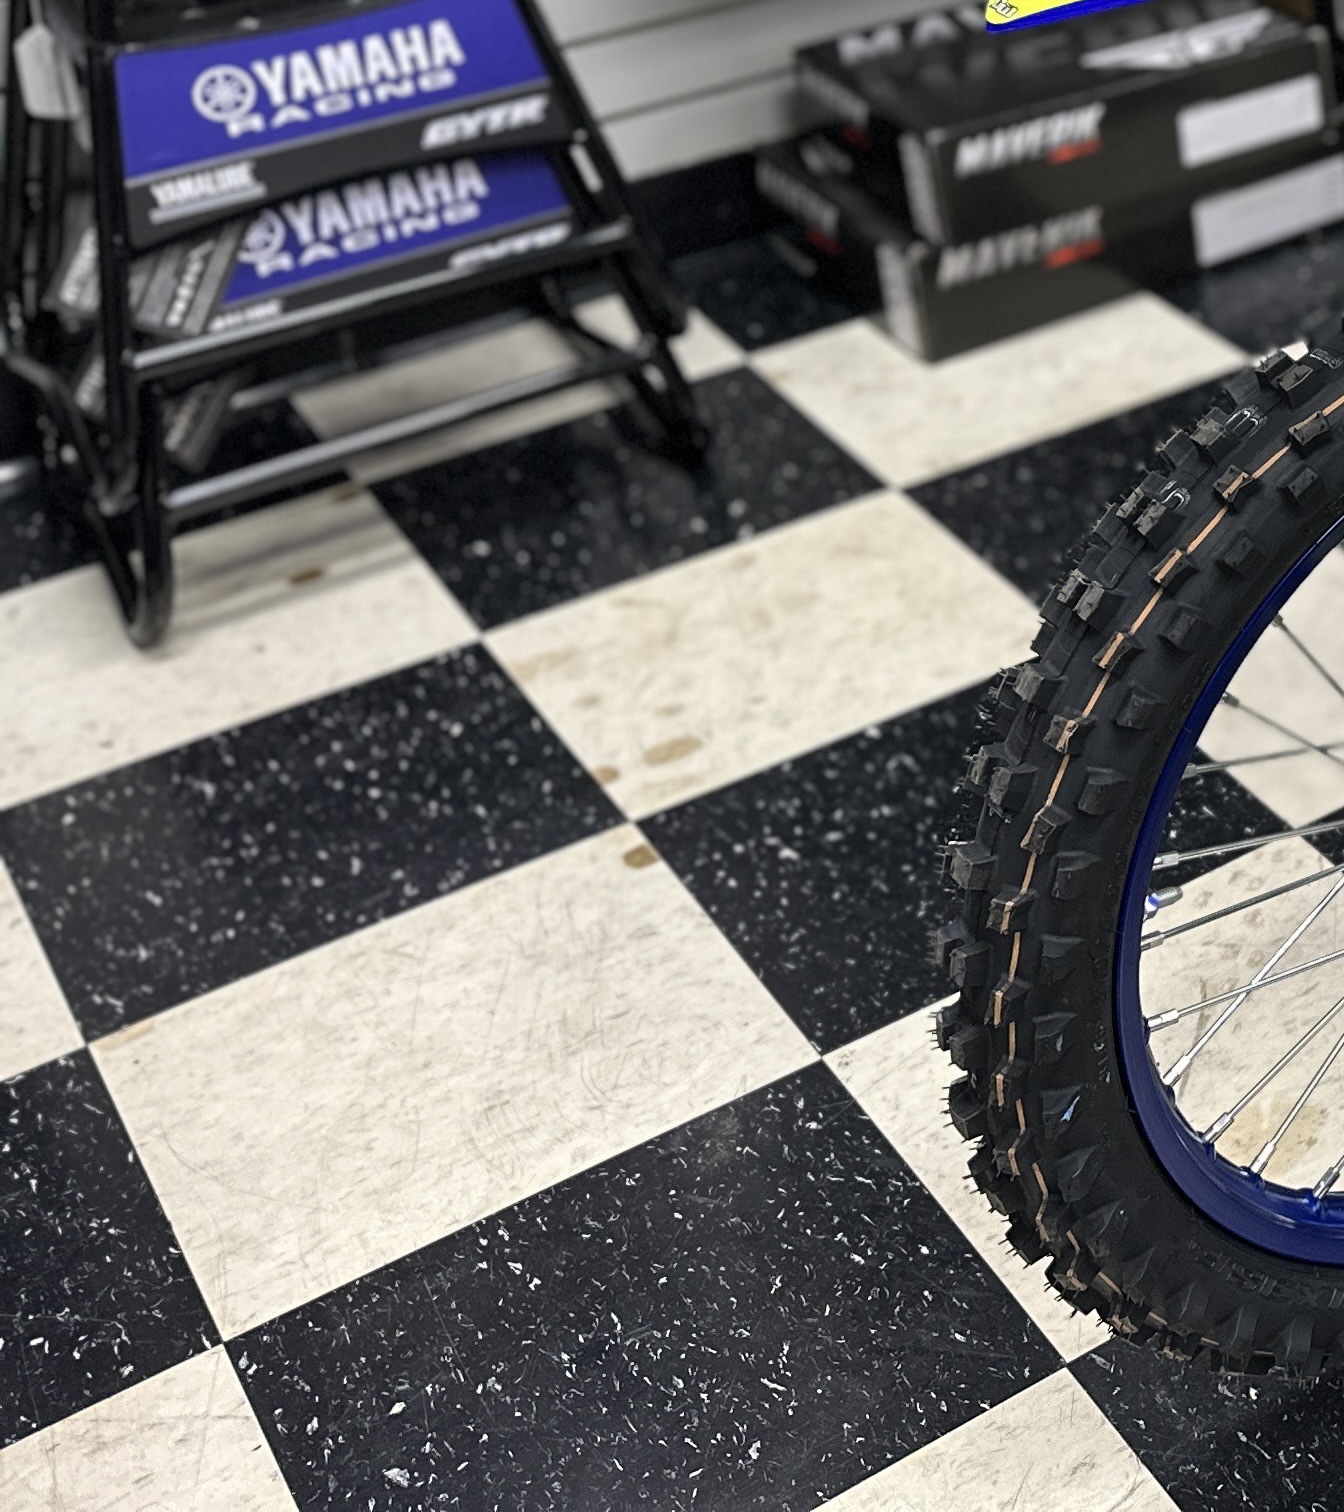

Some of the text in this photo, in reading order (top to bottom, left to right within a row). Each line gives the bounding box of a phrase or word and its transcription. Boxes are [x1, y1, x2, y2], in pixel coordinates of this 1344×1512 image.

[226, 67, 457, 139] RACING
[251, 18, 466, 106] YAMAHA
[256, 201, 482, 279] RACING
[281, 156, 490, 247] YAMAHA
